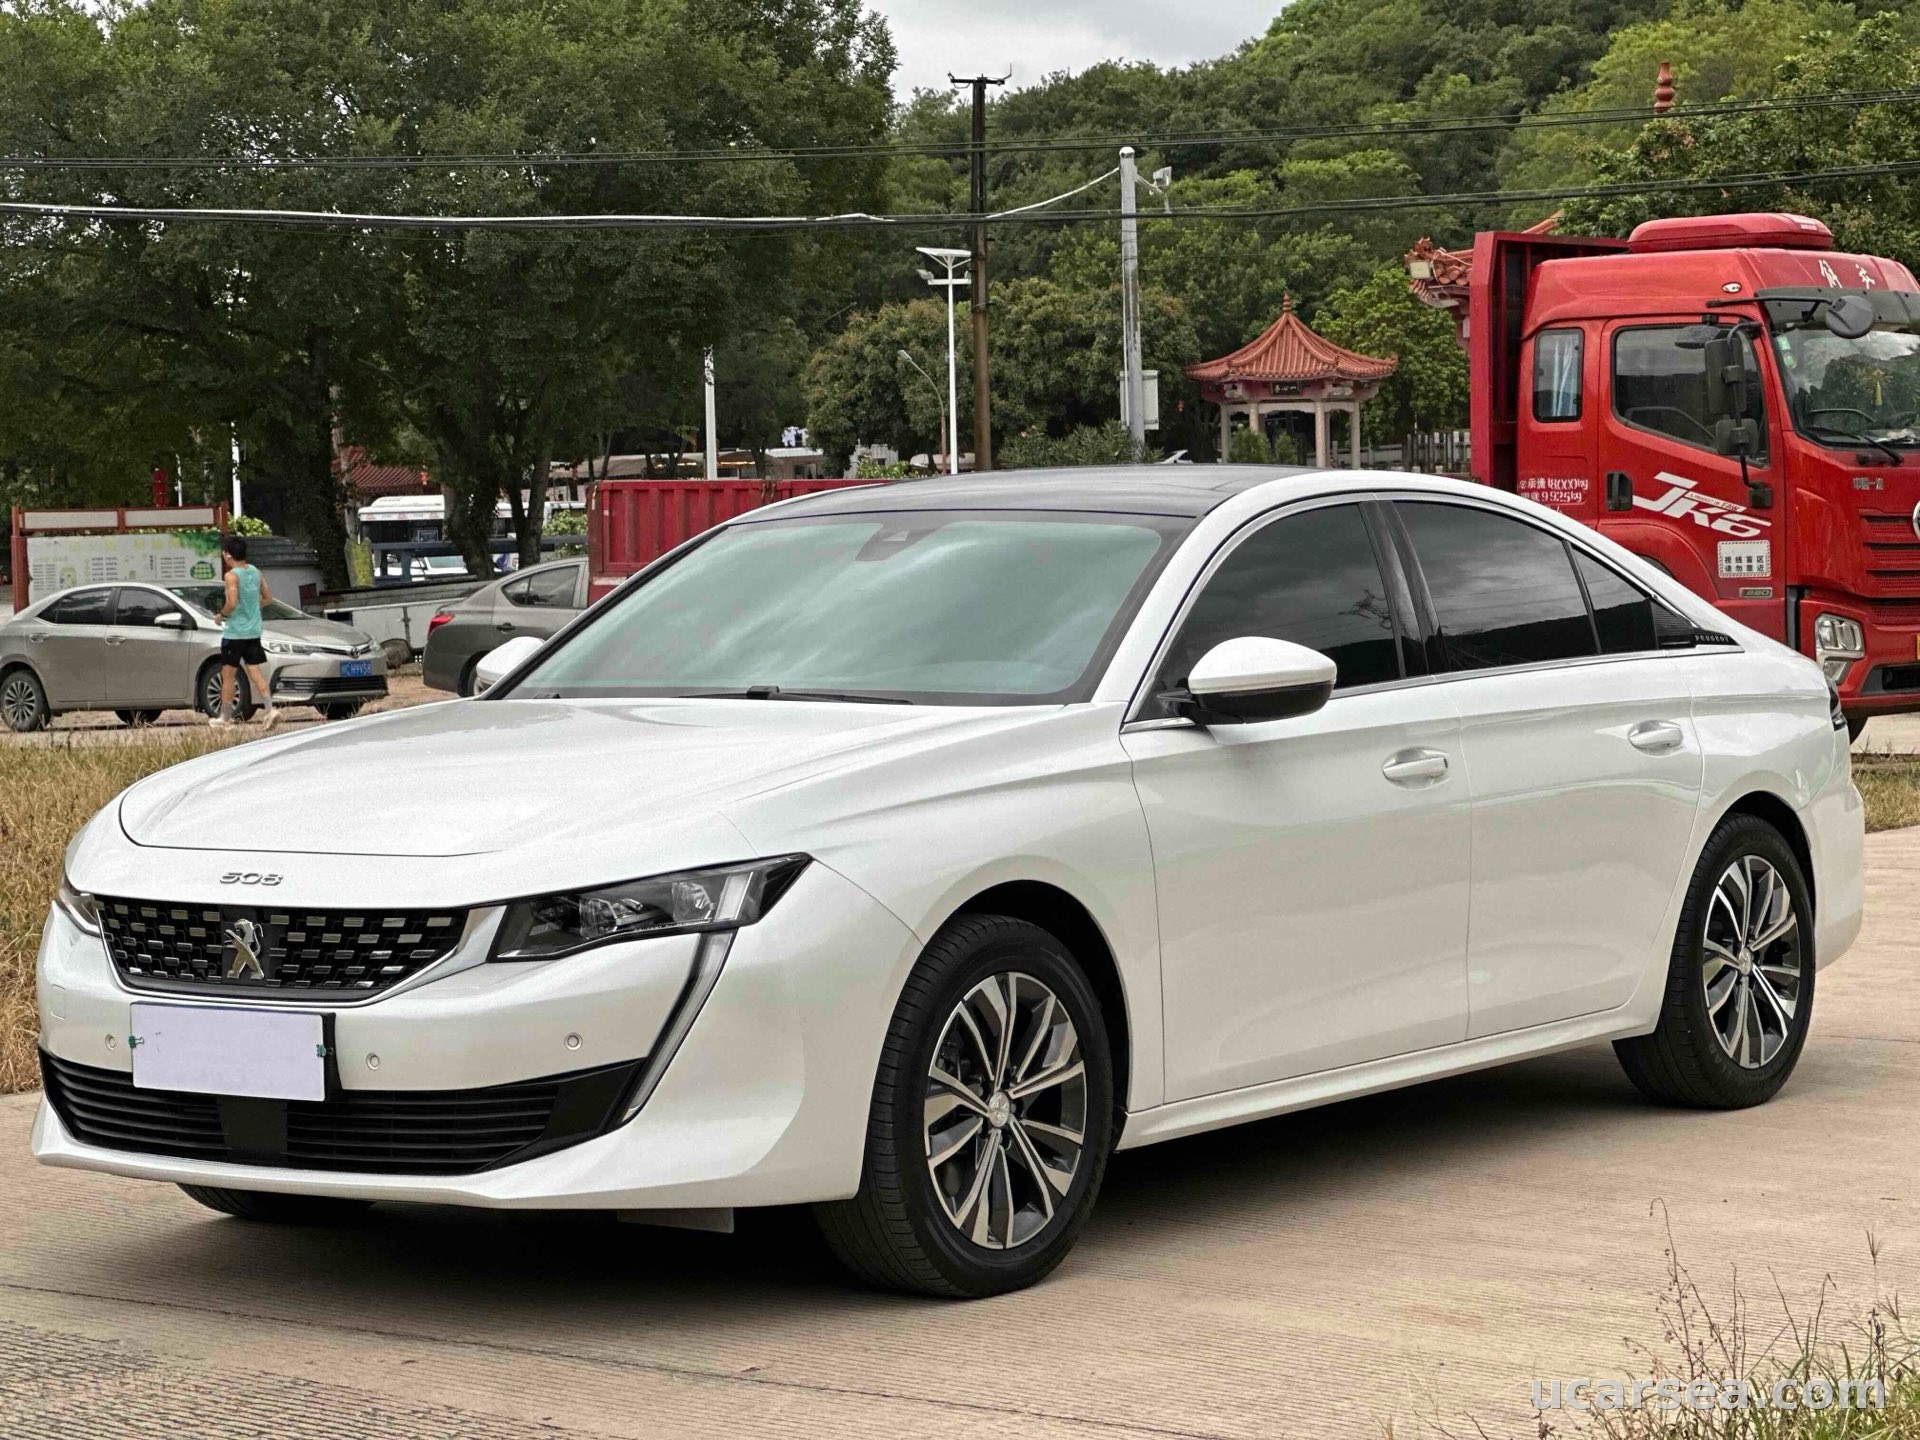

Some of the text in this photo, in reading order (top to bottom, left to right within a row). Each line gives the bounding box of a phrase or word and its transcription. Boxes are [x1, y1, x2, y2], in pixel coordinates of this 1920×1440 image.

[1721, 502, 1740, 512] FAW
[1724, 555, 1765, 564] 视线盲区
[1724, 564, 1765, 572] 请勿靠近
[219, 872, 284, 886] 508
